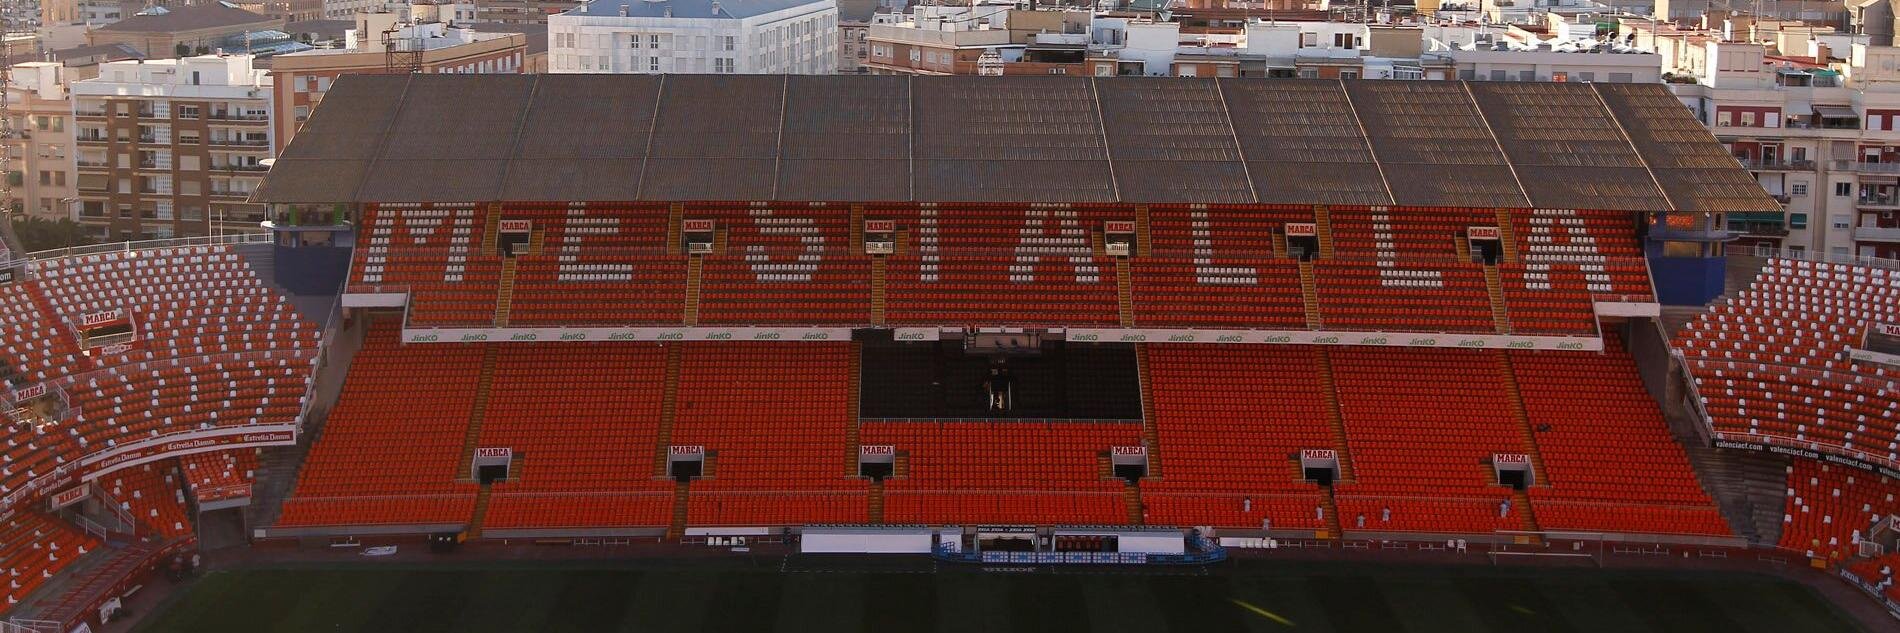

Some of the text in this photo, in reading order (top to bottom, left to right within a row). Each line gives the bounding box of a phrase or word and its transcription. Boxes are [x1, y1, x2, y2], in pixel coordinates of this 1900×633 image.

[501, 222, 529, 230] MARCA
[685, 221, 711, 230] MARCA
[866, 222, 893, 230] MARCA
[1107, 223, 1133, 231] MARCA
[1287, 225, 1314, 234] MARCA
[1470, 228, 1497, 237] MARCA
[85, 311, 116, 324] MARCA
[18, 385, 44, 400] MARCA
[479, 448, 509, 457] MARCA
[672, 446, 701, 454] MARCA
[863, 446, 892, 454] MARCA
[1114, 447, 1143, 455] MARCA
[1304, 450, 1333, 459] MARCA
[1497, 454, 1526, 463] MARCA
